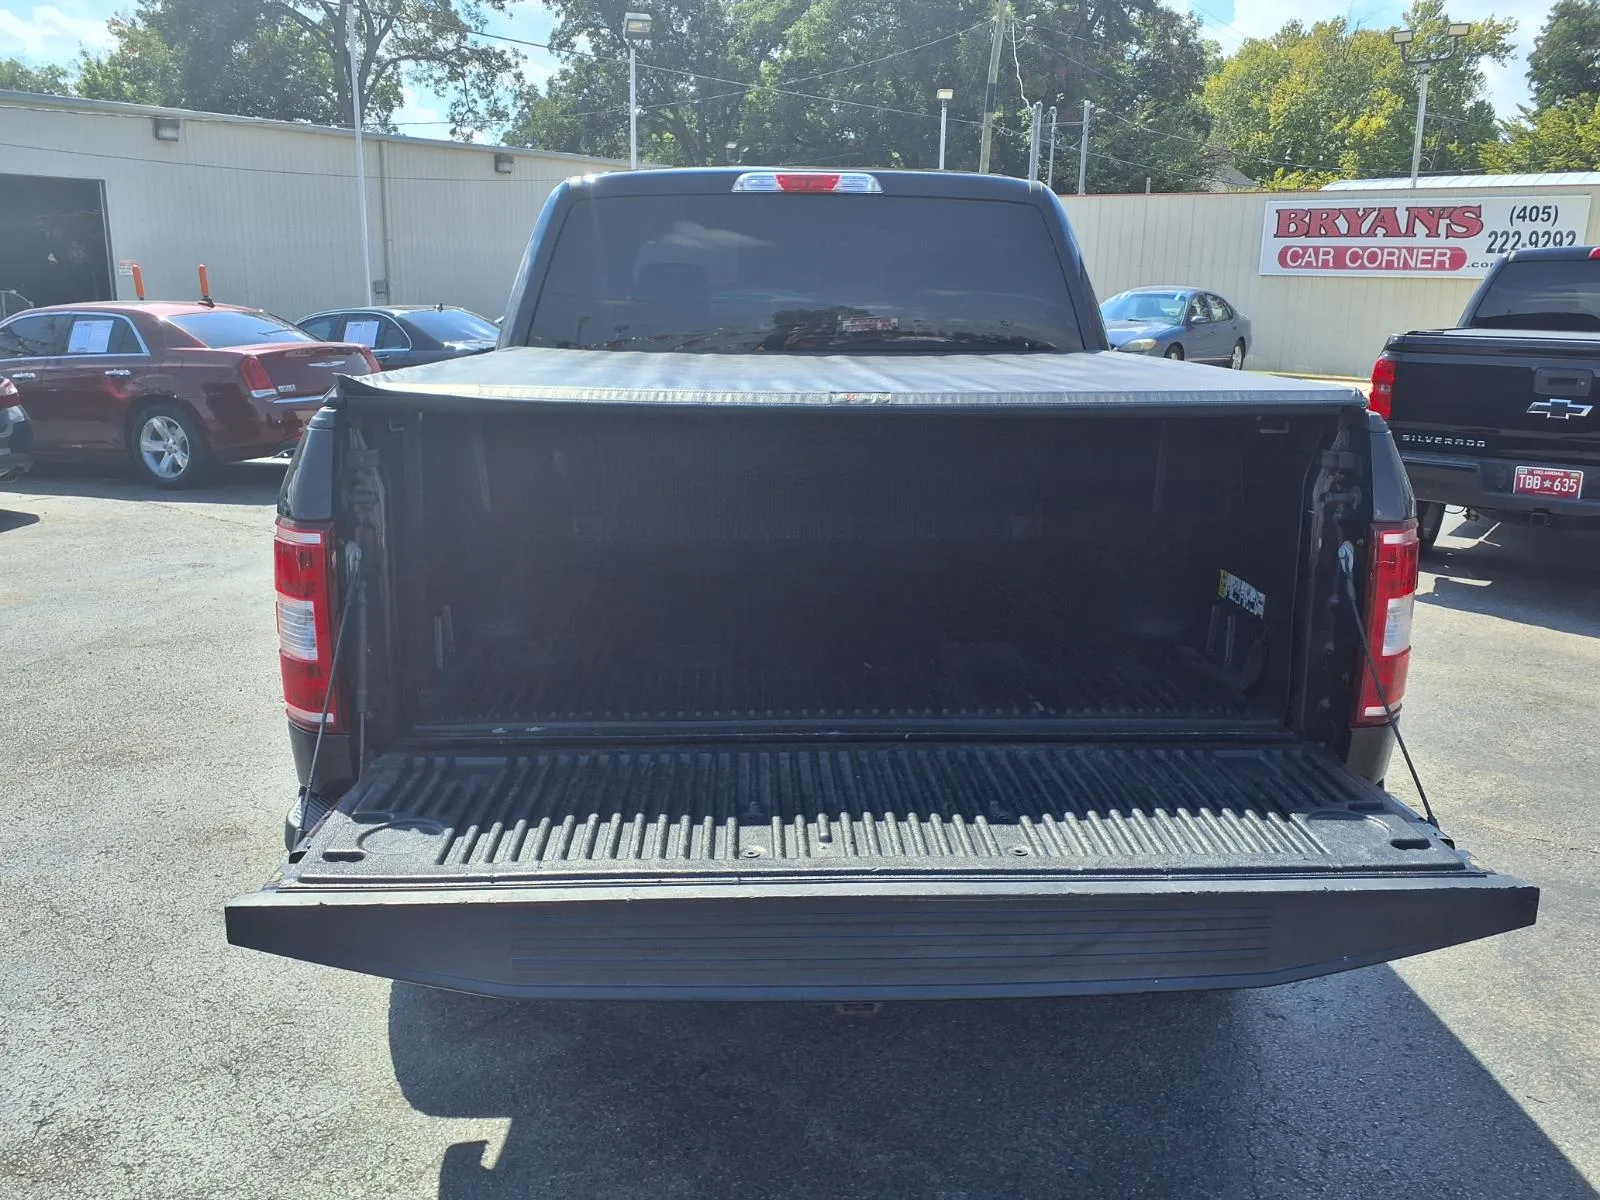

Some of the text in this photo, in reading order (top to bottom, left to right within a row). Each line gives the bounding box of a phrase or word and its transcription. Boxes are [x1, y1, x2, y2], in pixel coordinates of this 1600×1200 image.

[1274, 204, 1484, 240] BRYAN'S
[1509, 205, 1558, 227] (405)
[1286, 247, 1494, 269] CAR CORNER .co
[1401, 434, 1486, 447] SILVERADO
[1519, 474, 1578, 493] TBB 635
